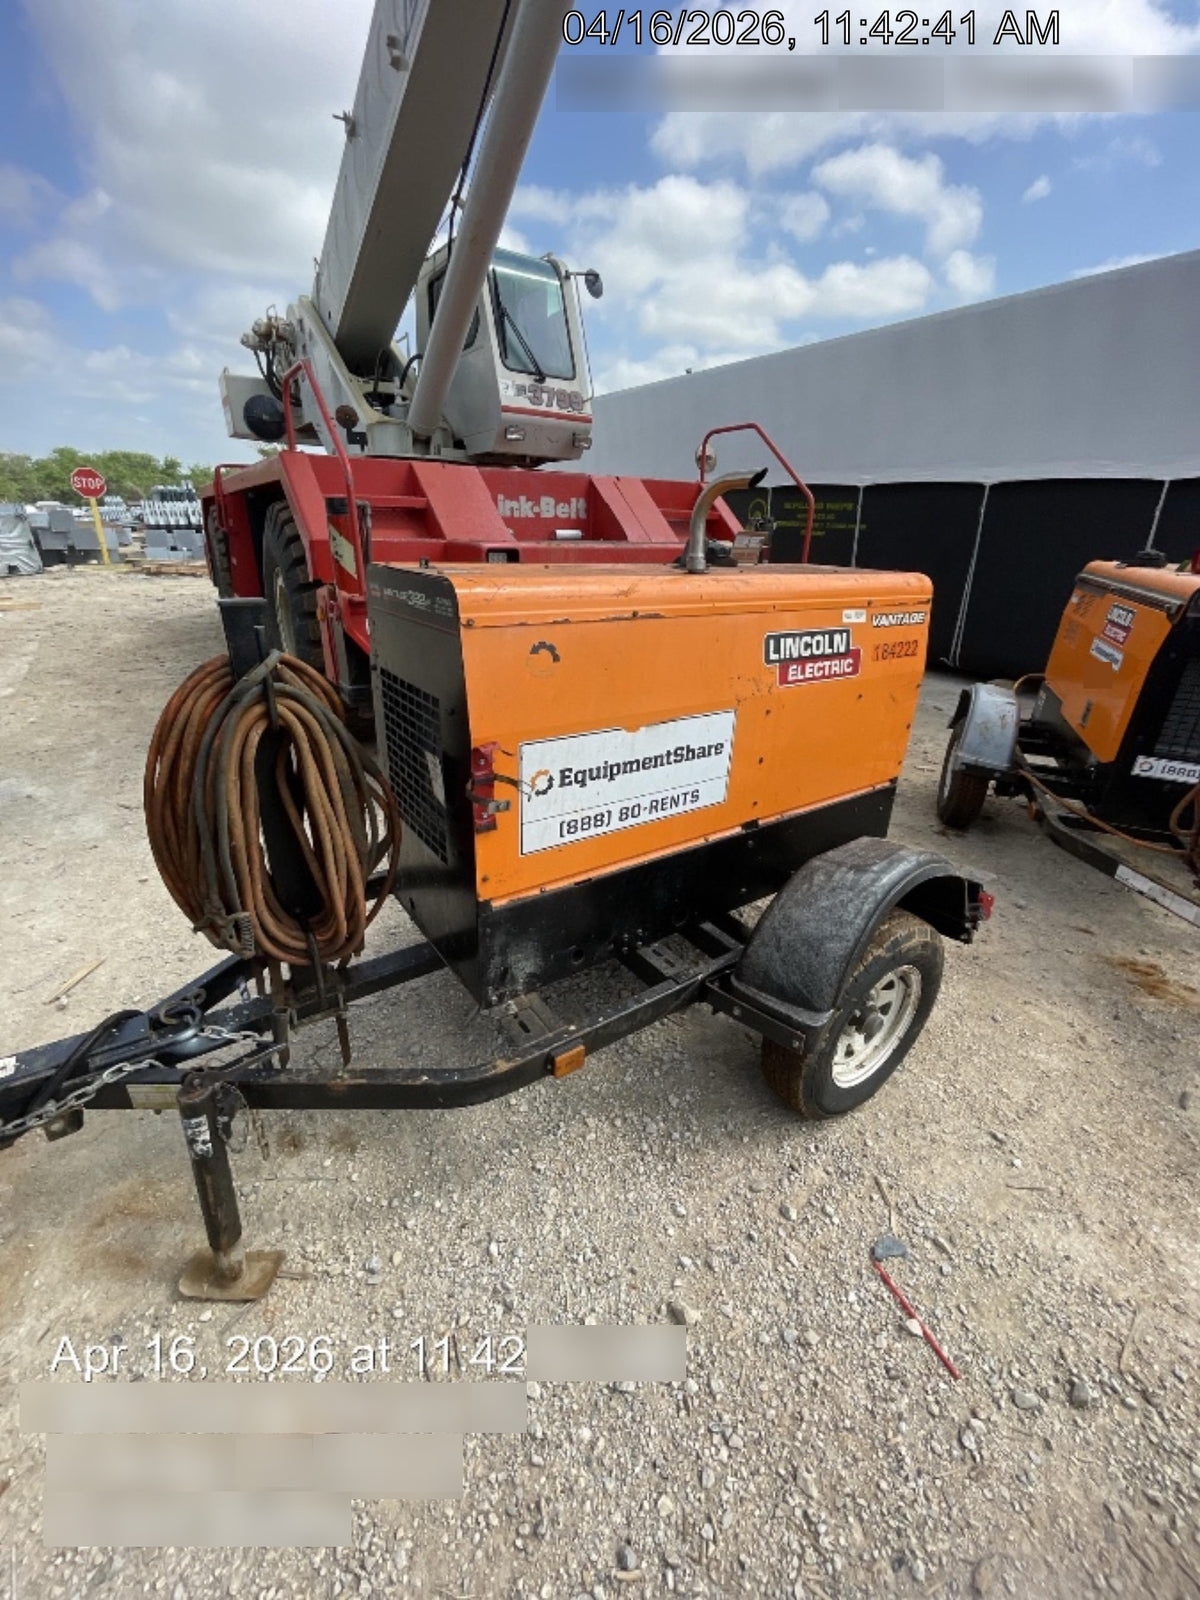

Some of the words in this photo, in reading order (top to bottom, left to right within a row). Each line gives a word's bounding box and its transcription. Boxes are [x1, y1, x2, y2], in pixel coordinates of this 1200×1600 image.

[74, 476, 103, 490] STOP
[497, 494, 587, 519] ink-Belt
[872, 612, 927, 628] VANTAGE
[769, 632, 847, 660] LINCOLN
[873, 639, 919, 662] 184222
[787, 658, 854, 681] ELECTRIC
[558, 741, 725, 788] EquipmentShare
[618, 789, 700, 822] 80-RENTS
